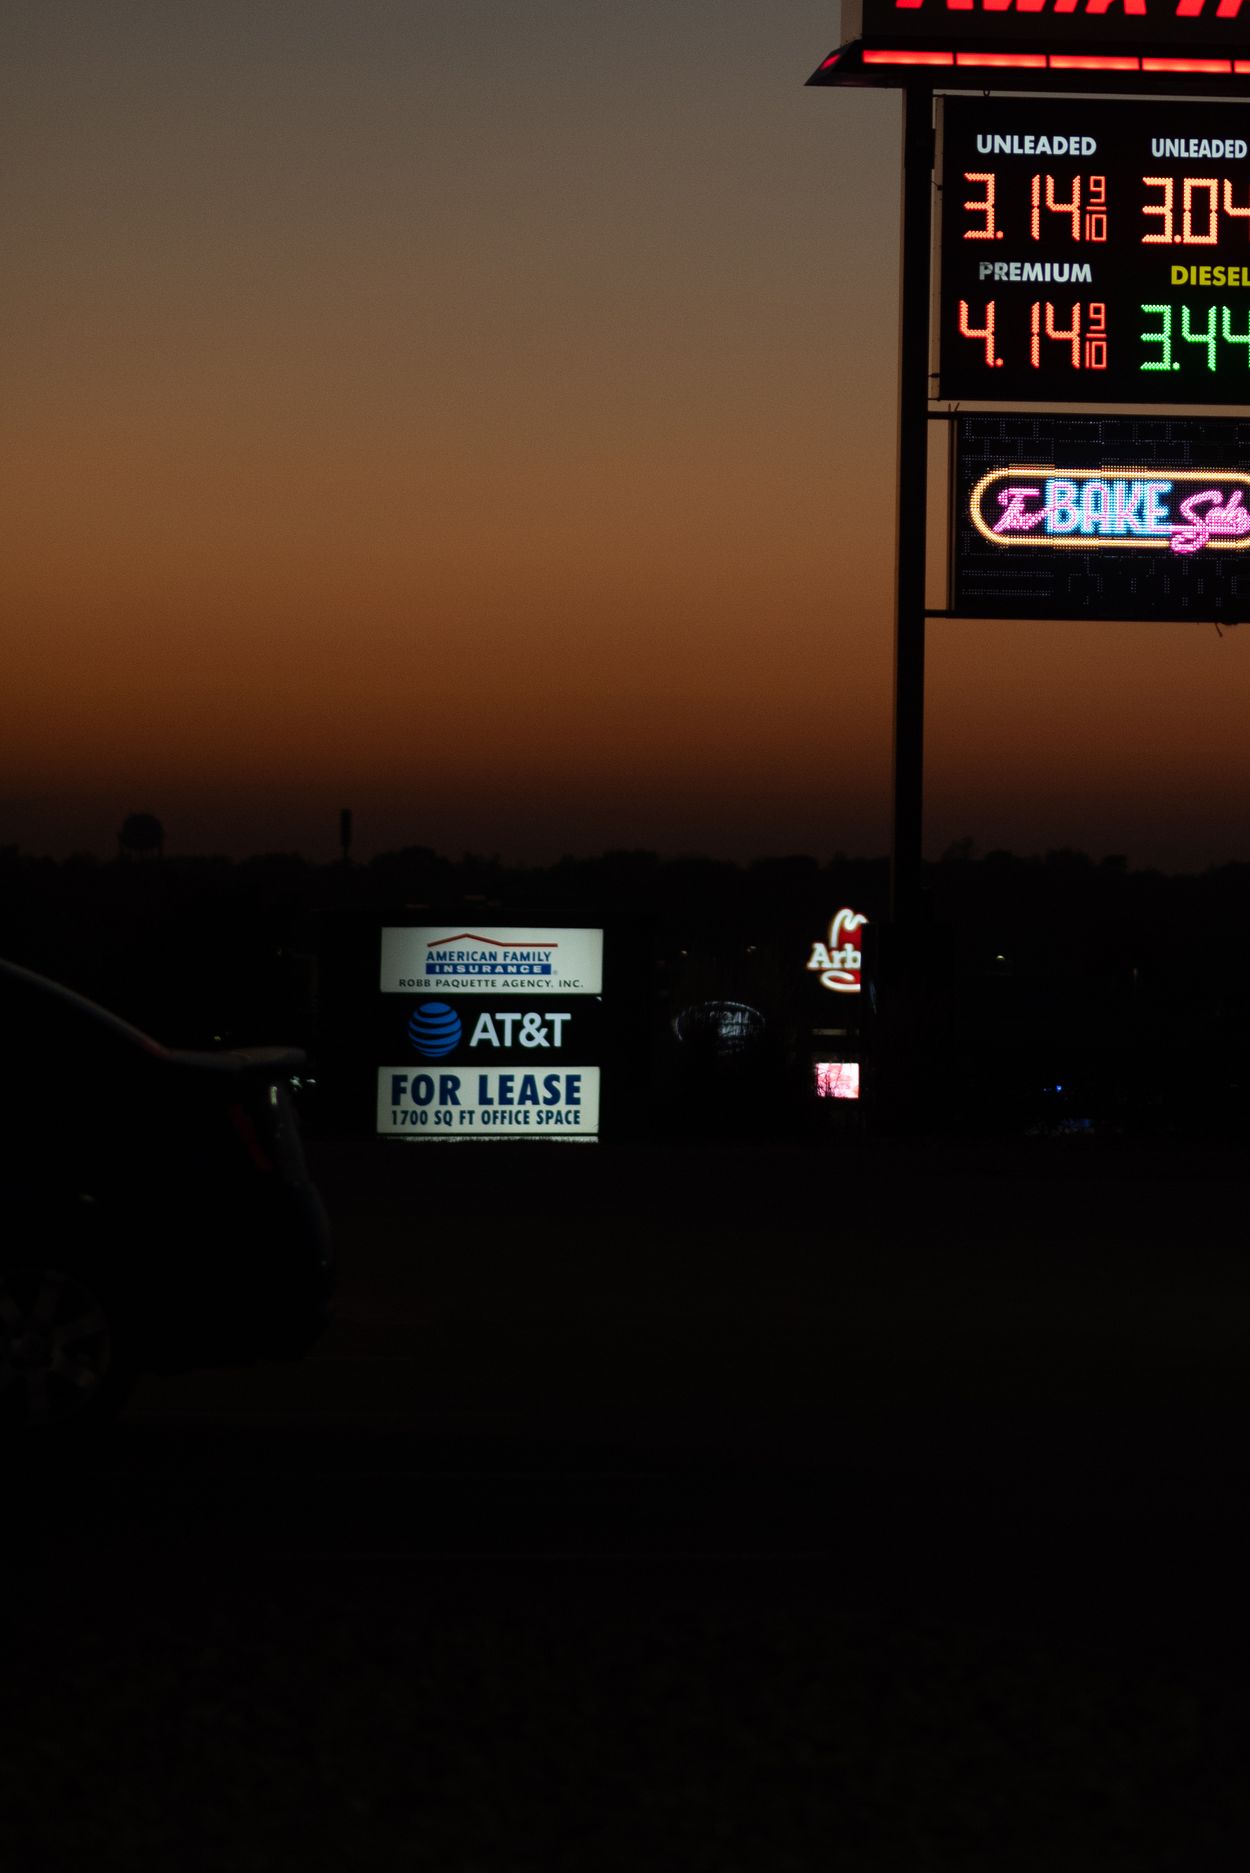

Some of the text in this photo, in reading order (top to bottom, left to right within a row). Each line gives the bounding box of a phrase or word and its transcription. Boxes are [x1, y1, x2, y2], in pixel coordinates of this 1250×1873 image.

[977, 135, 1096, 155] UNLEADED
[1152, 139, 1247, 158] UNLEADED
[980, 263, 1092, 282] PREMIUM
[1045, 478, 1173, 536] BAKE
[426, 951, 551, 962] AMERICAN FAMILY
[436, 965, 541, 973] INSURANCE
[399, 979, 431, 988] ROBB
[435, 979, 497, 989] PAQUETTE
[559, 980, 584, 988] INC.
[470, 1013, 571, 1047] AT&T
[391, 1074, 581, 1106] FOR LEASE
[391, 1110, 580, 1126] 1700 SQ FT OFFICE SPACE
